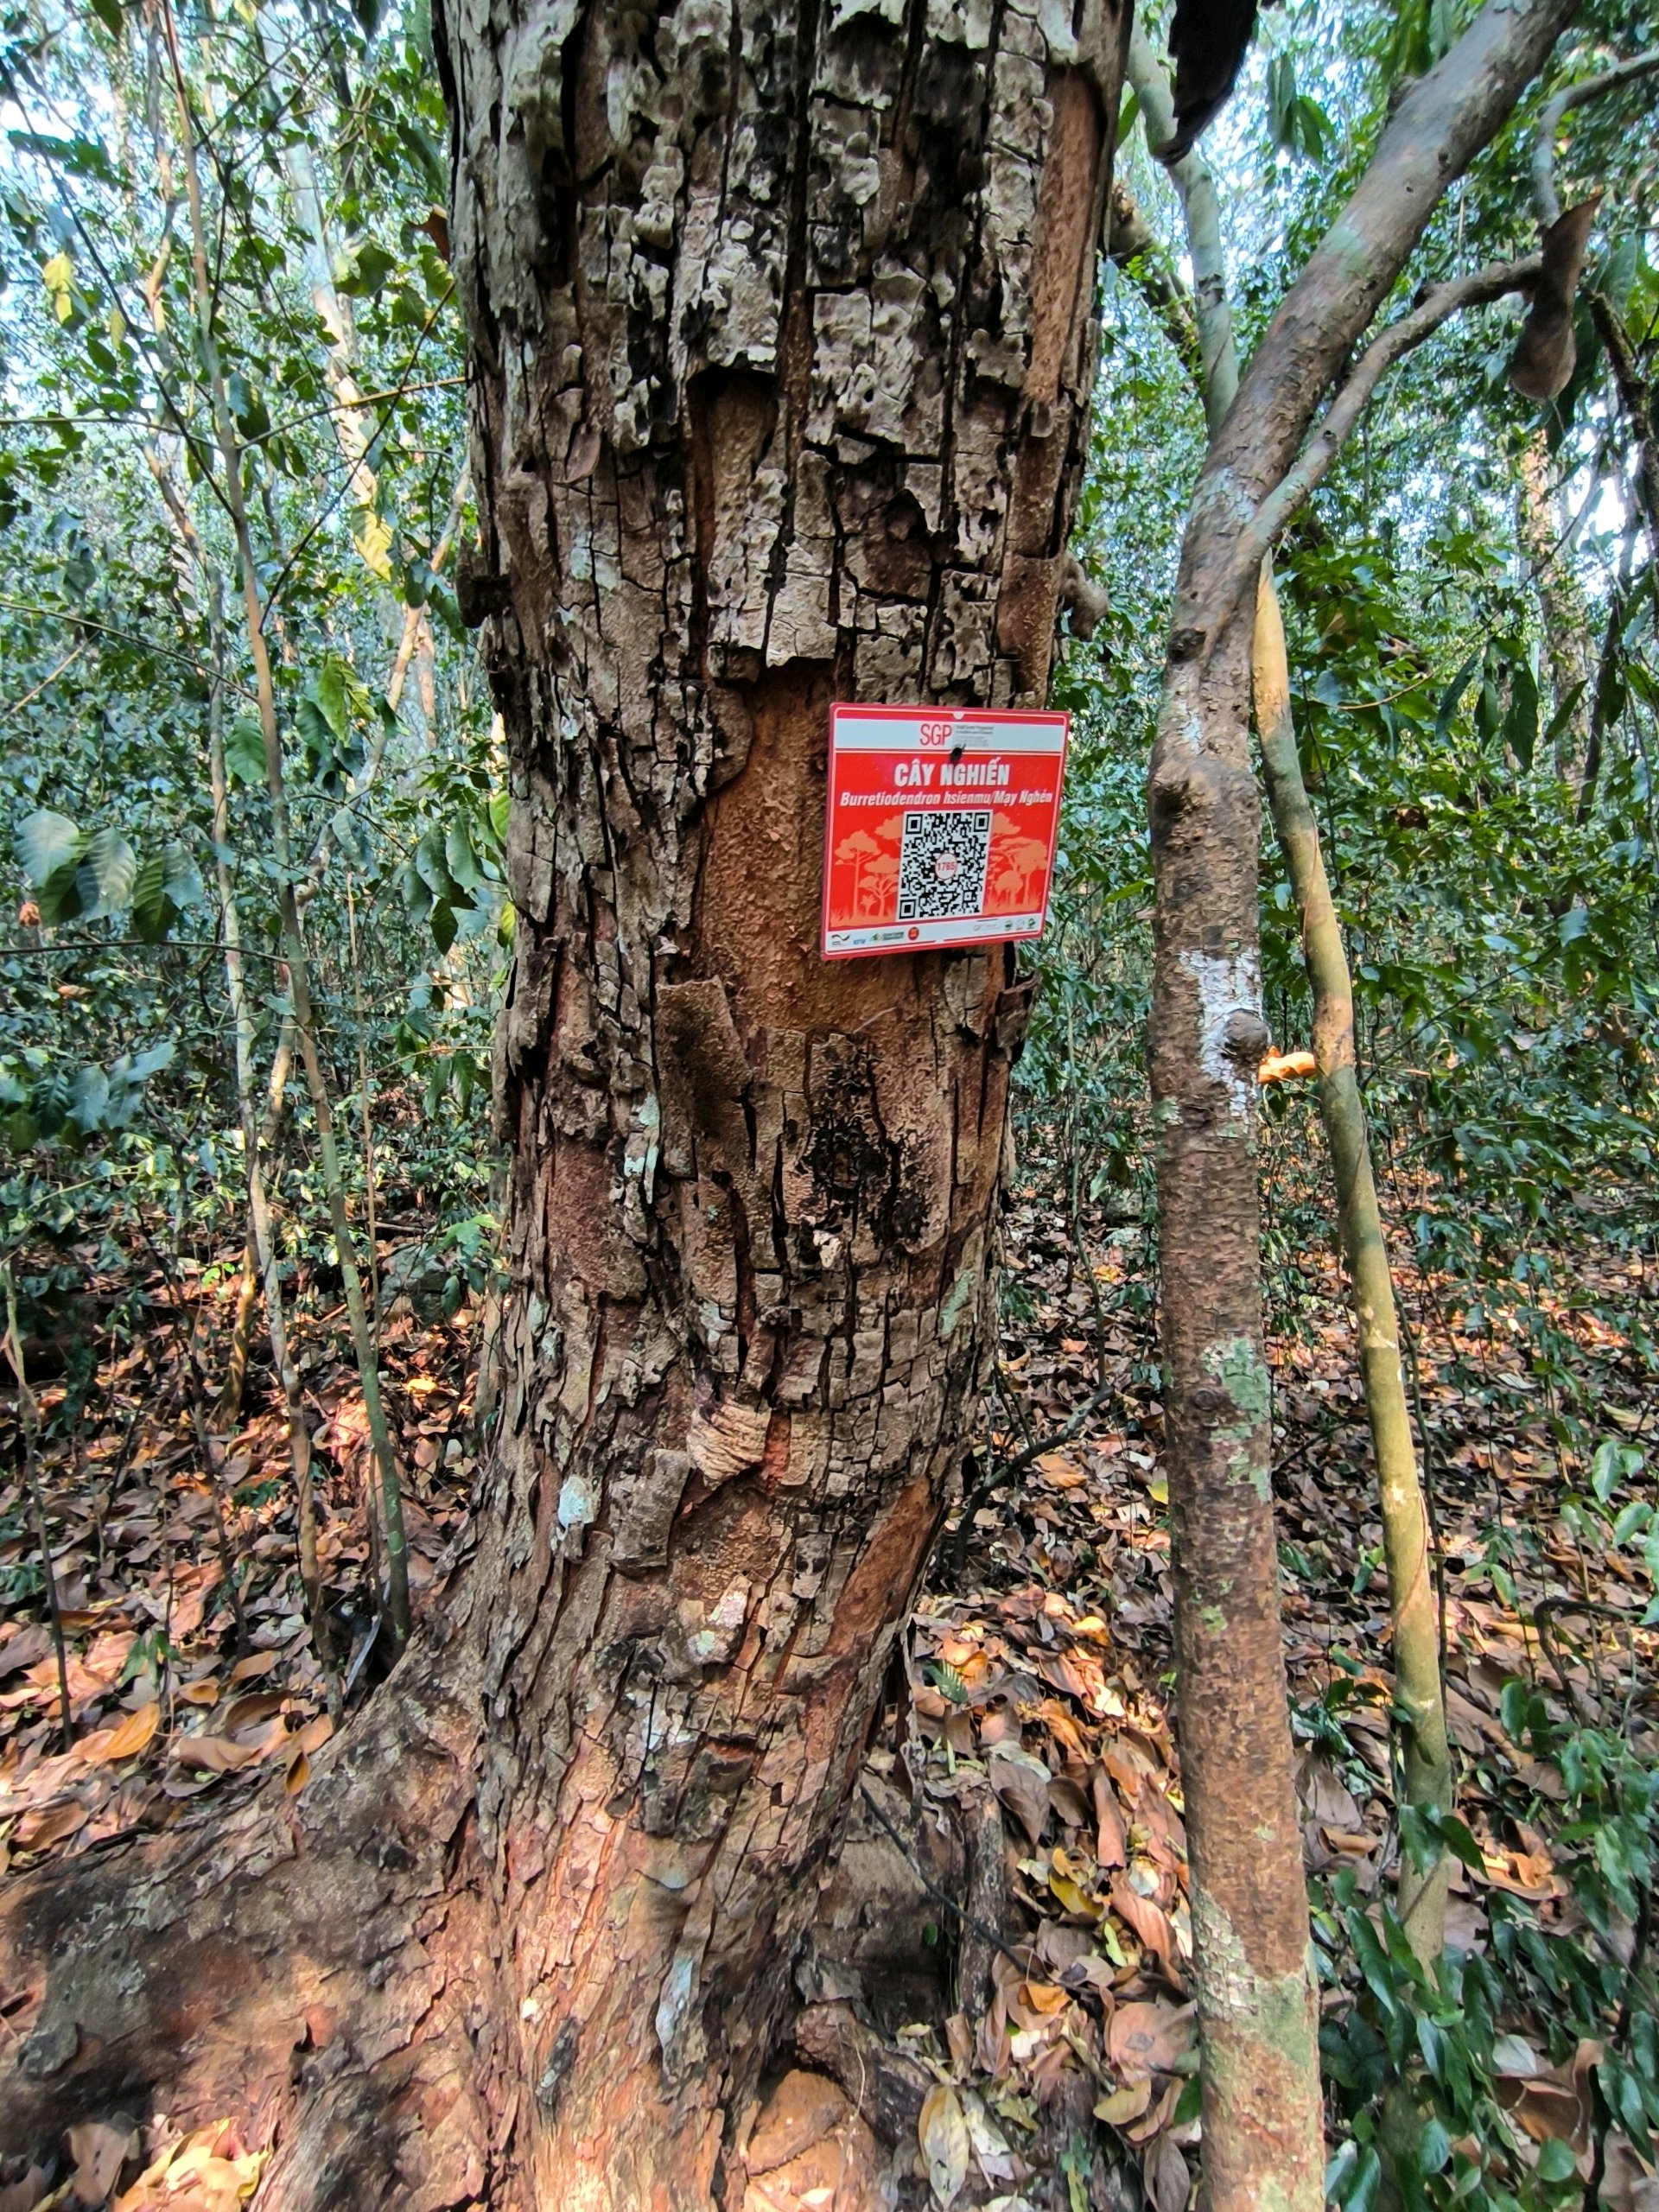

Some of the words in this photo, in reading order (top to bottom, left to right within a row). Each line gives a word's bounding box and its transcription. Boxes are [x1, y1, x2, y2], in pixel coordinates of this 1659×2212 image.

[919, 723, 952, 746] SGP
[893, 758, 936, 787] CÂY
[939, 756, 1010, 786] NGHIẾN
[840, 791, 942, 806] Burretiodendron
